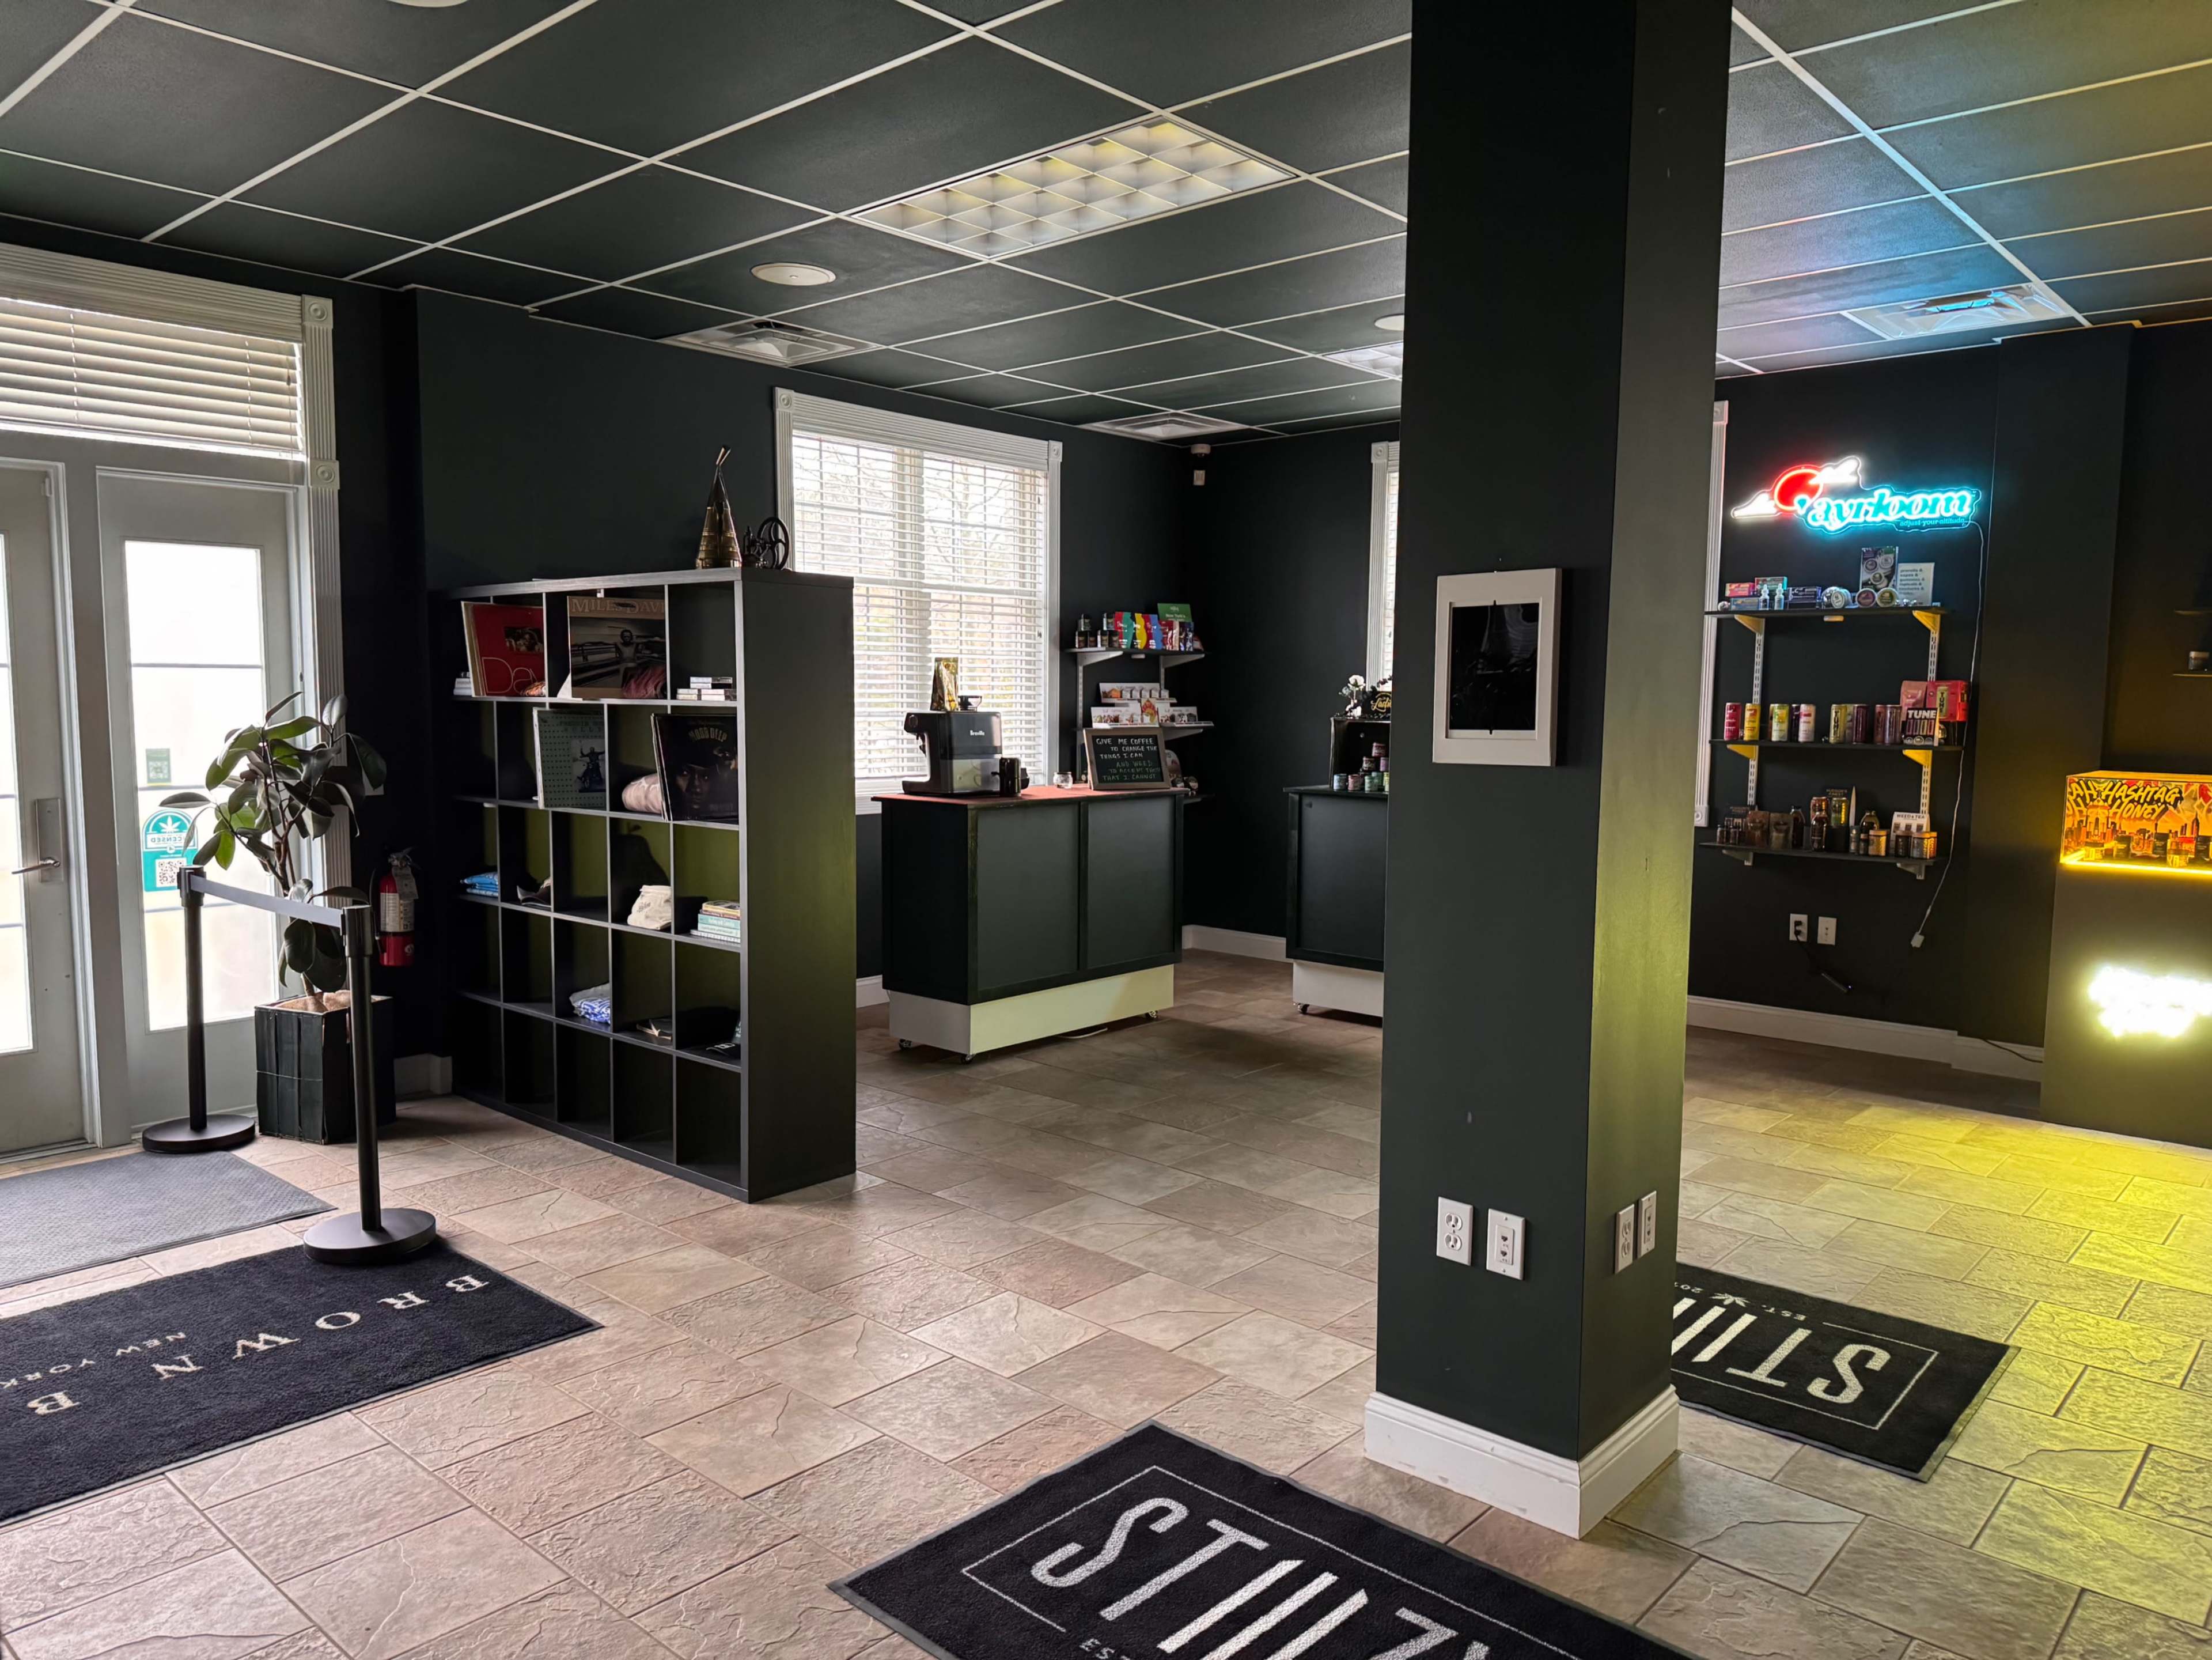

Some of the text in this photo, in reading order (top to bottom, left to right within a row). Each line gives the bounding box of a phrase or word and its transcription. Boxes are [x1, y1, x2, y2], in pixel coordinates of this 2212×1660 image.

[1808, 489, 1972, 530] ayrloom
[626, 601, 664, 614] DAVI
[1907, 710, 1937, 719] TUNE
[1116, 760, 1130, 768] AND
[2101, 780, 2181, 806] HASHTAG
[2108, 799, 2165, 823] HONEY
[1673, 1281, 1807, 1322] EST. 201
[151, 1274, 488, 1381] BROWN
[116, 1332, 186, 1356] NEW
[1671, 1297, 1891, 1404] STII
[1030, 1497, 1493, 1660] STIIIZ
[1079, 1638, 1131, 1660] ES
